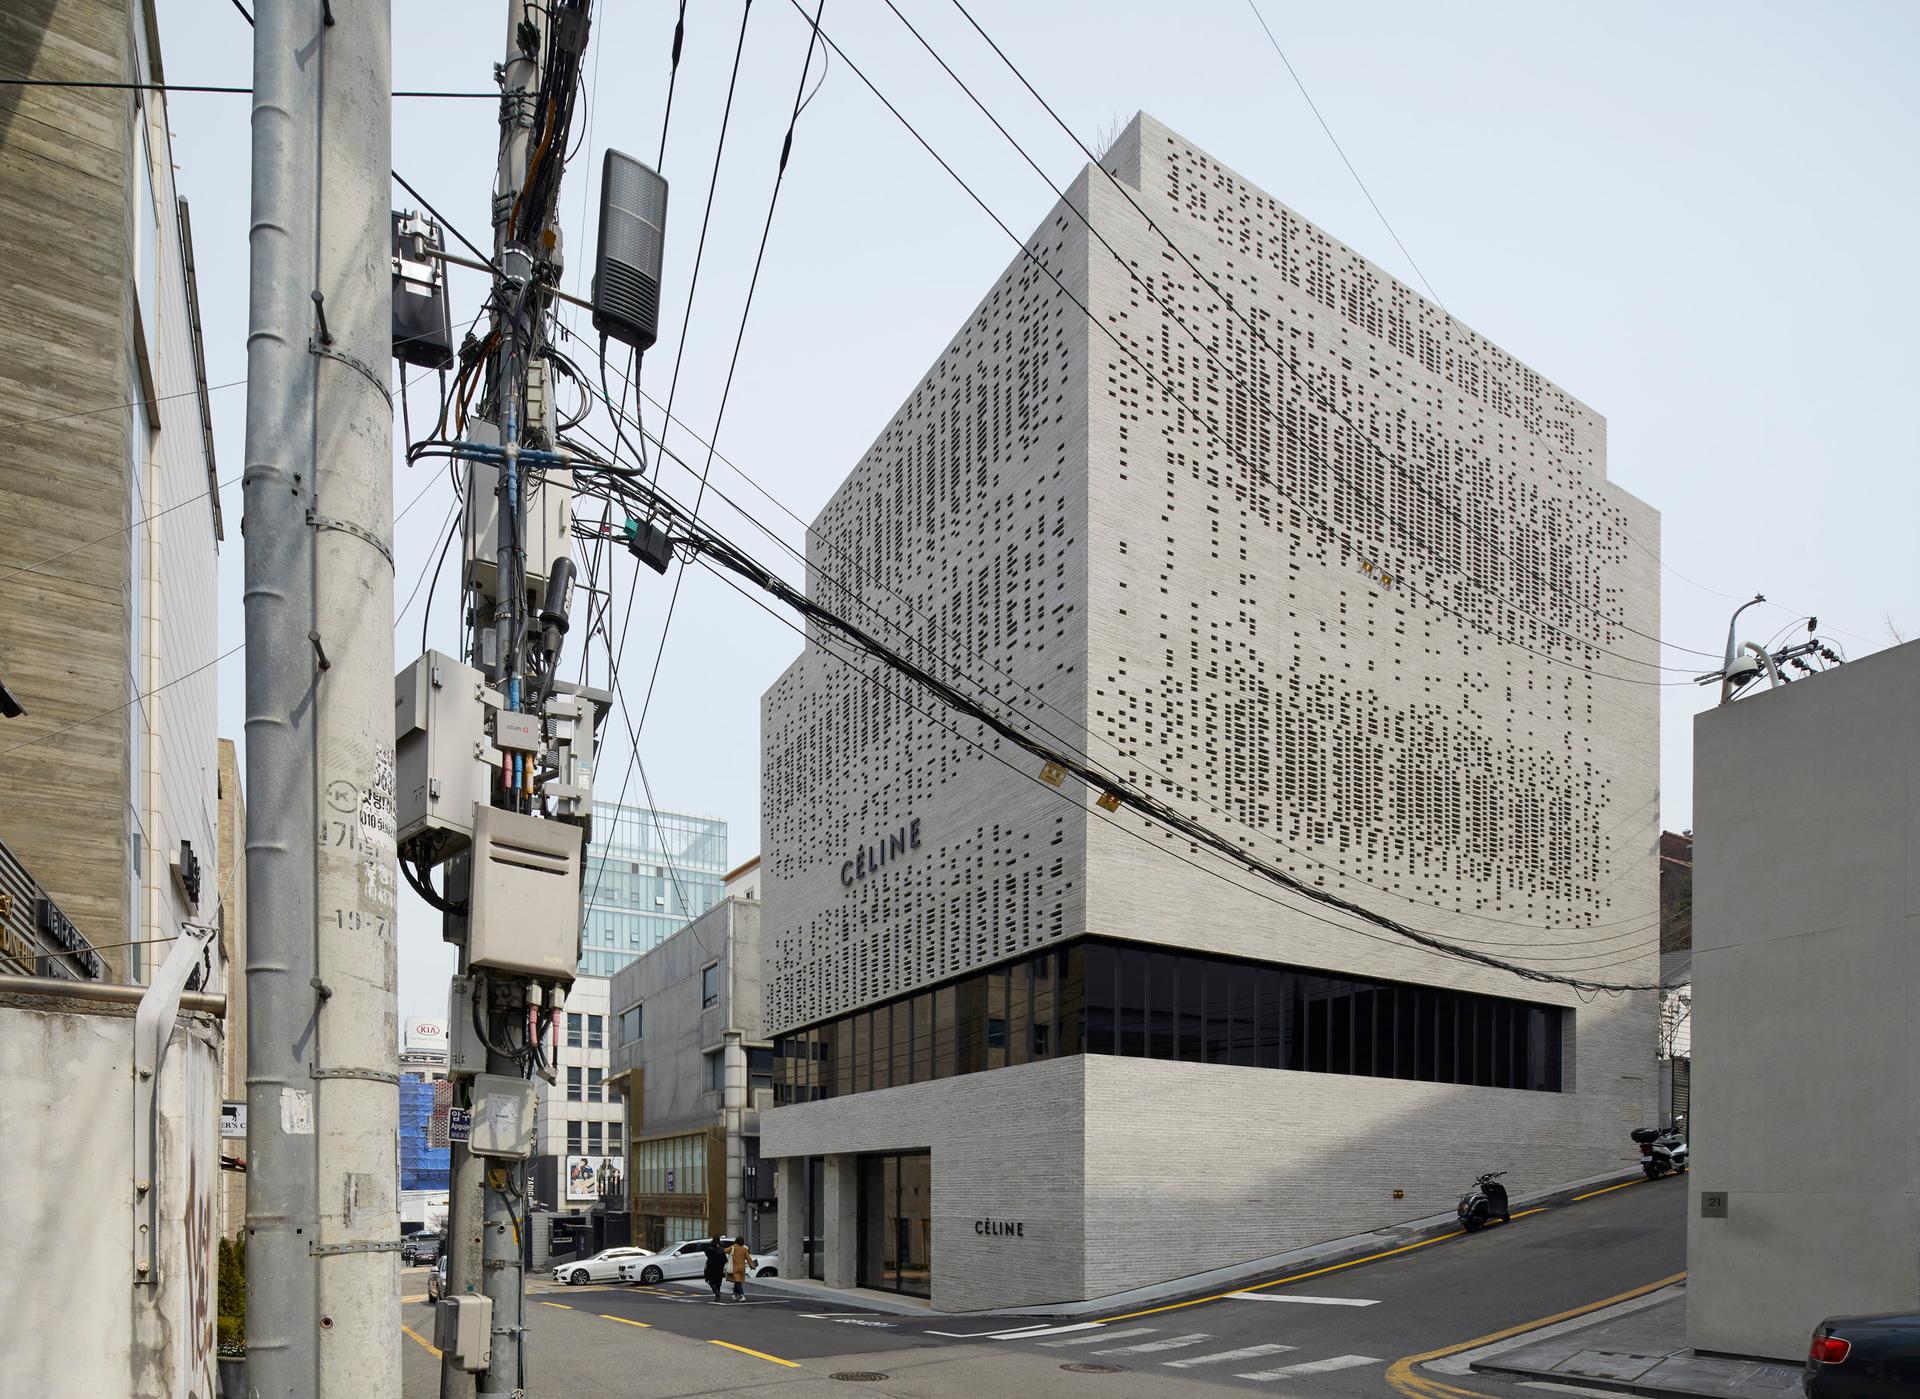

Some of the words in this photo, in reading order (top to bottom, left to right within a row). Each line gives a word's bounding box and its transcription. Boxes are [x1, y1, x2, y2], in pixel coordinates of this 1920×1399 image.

[841, 817, 921, 887] CÉLINE
[418, 1025, 438, 1034] KIA
[975, 1217, 1024, 1237] CÉLINE
